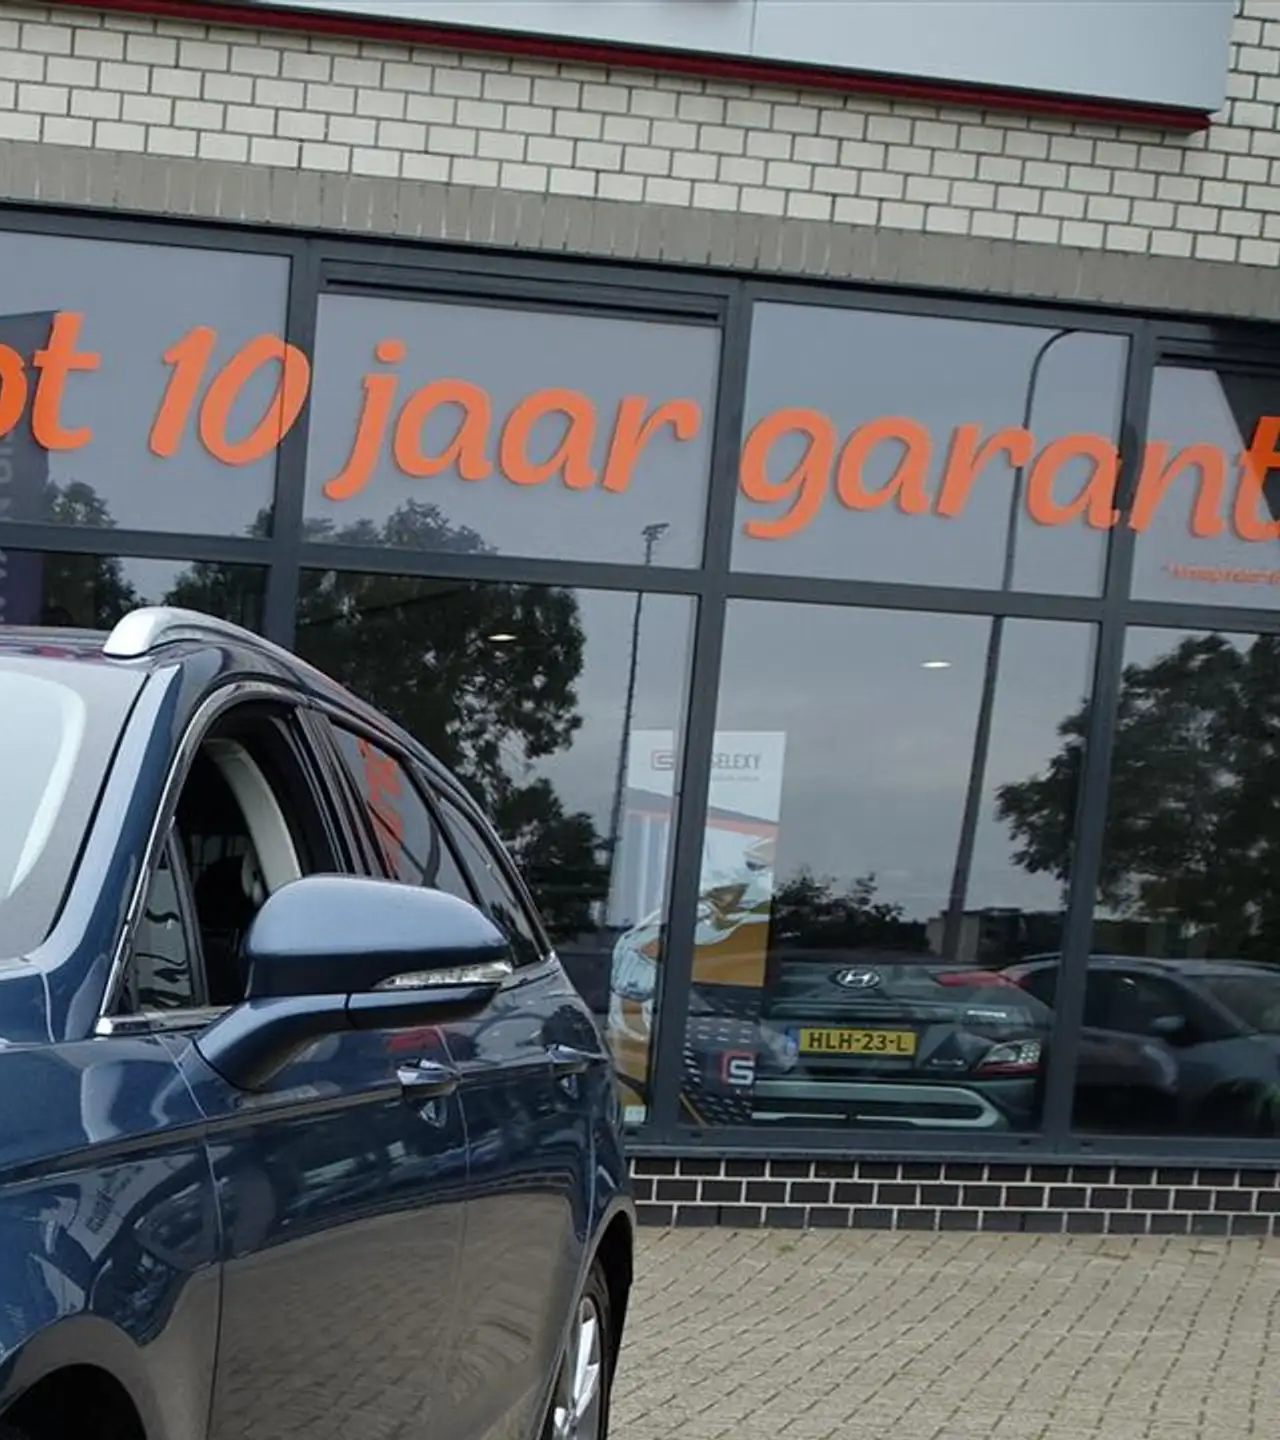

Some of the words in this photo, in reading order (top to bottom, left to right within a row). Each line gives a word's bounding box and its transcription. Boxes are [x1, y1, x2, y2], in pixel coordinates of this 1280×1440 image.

[149, 326, 310, 466] 10
[324, 339, 700, 501] jaar
[807, 1031, 910, 1052] HLH-23-L
